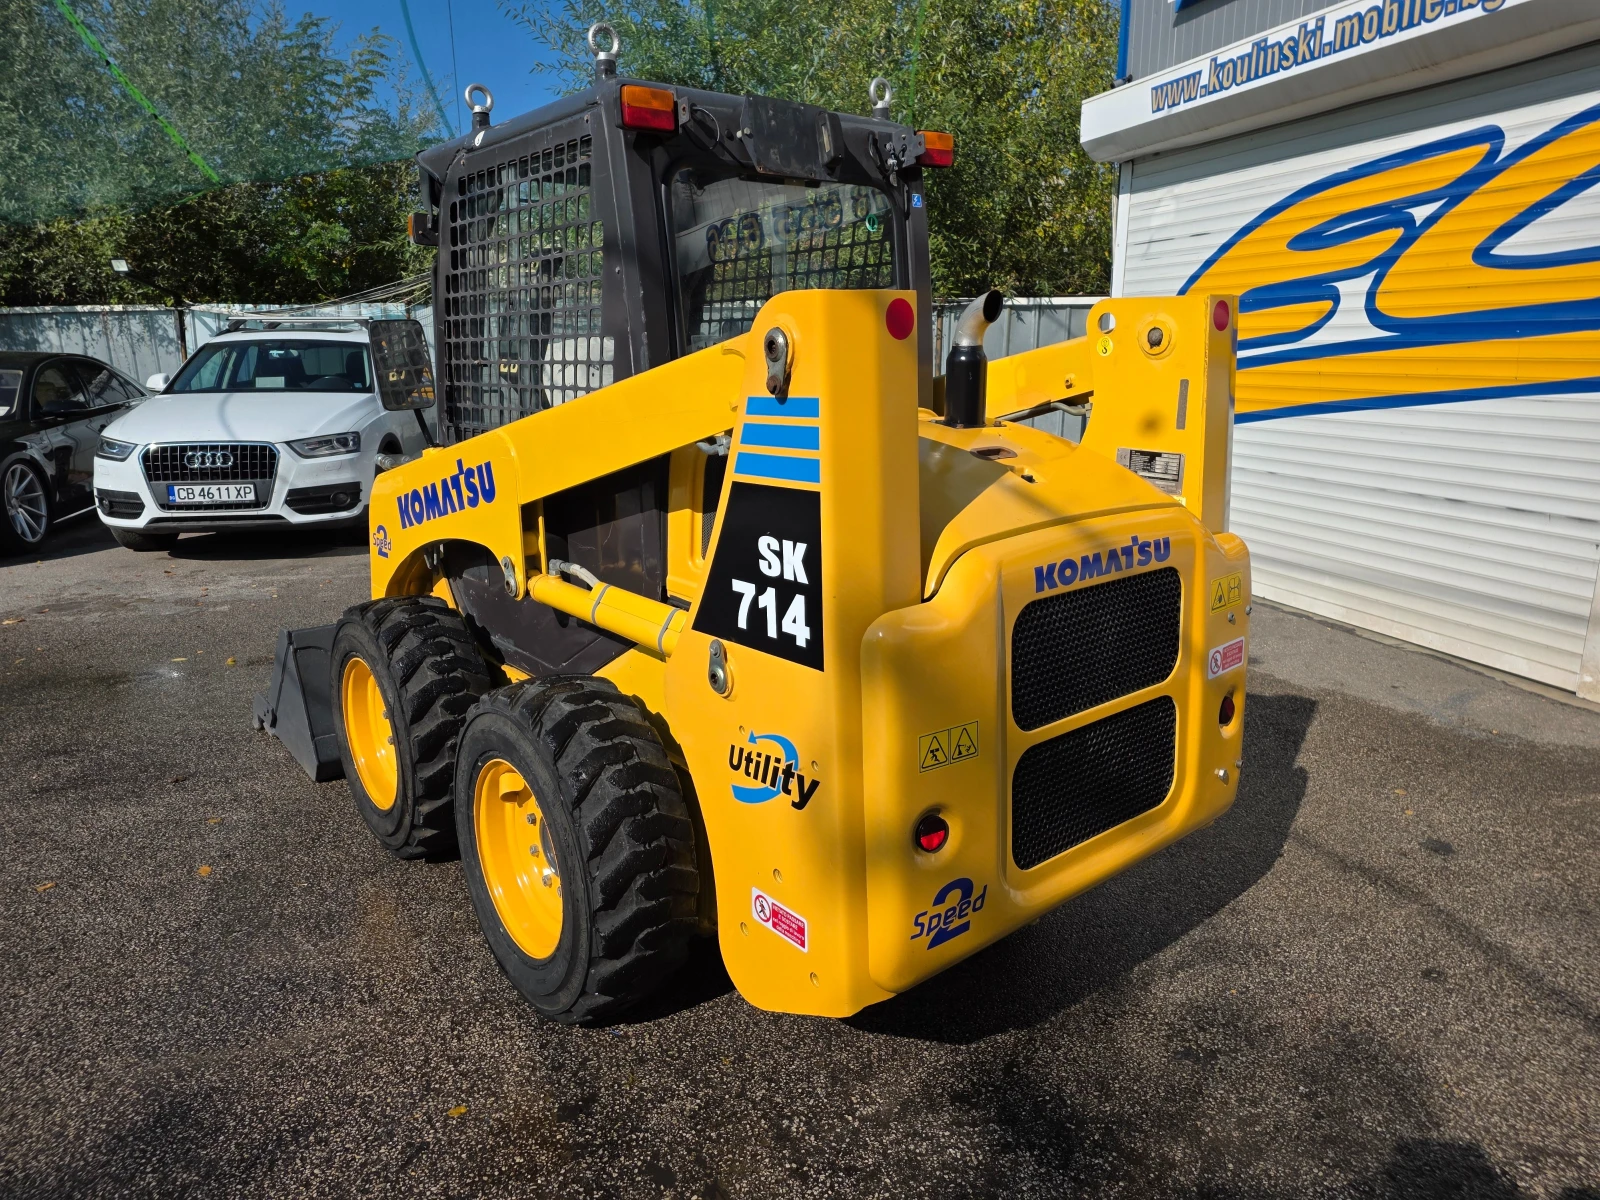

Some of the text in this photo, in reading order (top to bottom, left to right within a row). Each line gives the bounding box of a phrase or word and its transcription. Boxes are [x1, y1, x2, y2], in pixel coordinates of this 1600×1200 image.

[1151, 0, 1506, 113] www.koulinski.mobile.
[177, 486, 252, 500] CB 4611 XP
[397, 458, 496, 529] KOMATSU
[372, 532, 392, 552] Speed
[757, 535, 809, 584] SK
[1034, 535, 1170, 594] KOMATSU
[731, 578, 811, 648] 714
[728, 744, 821, 810] Utility
[909, 884, 988, 940] Speed
[927, 877, 974, 951] 2
